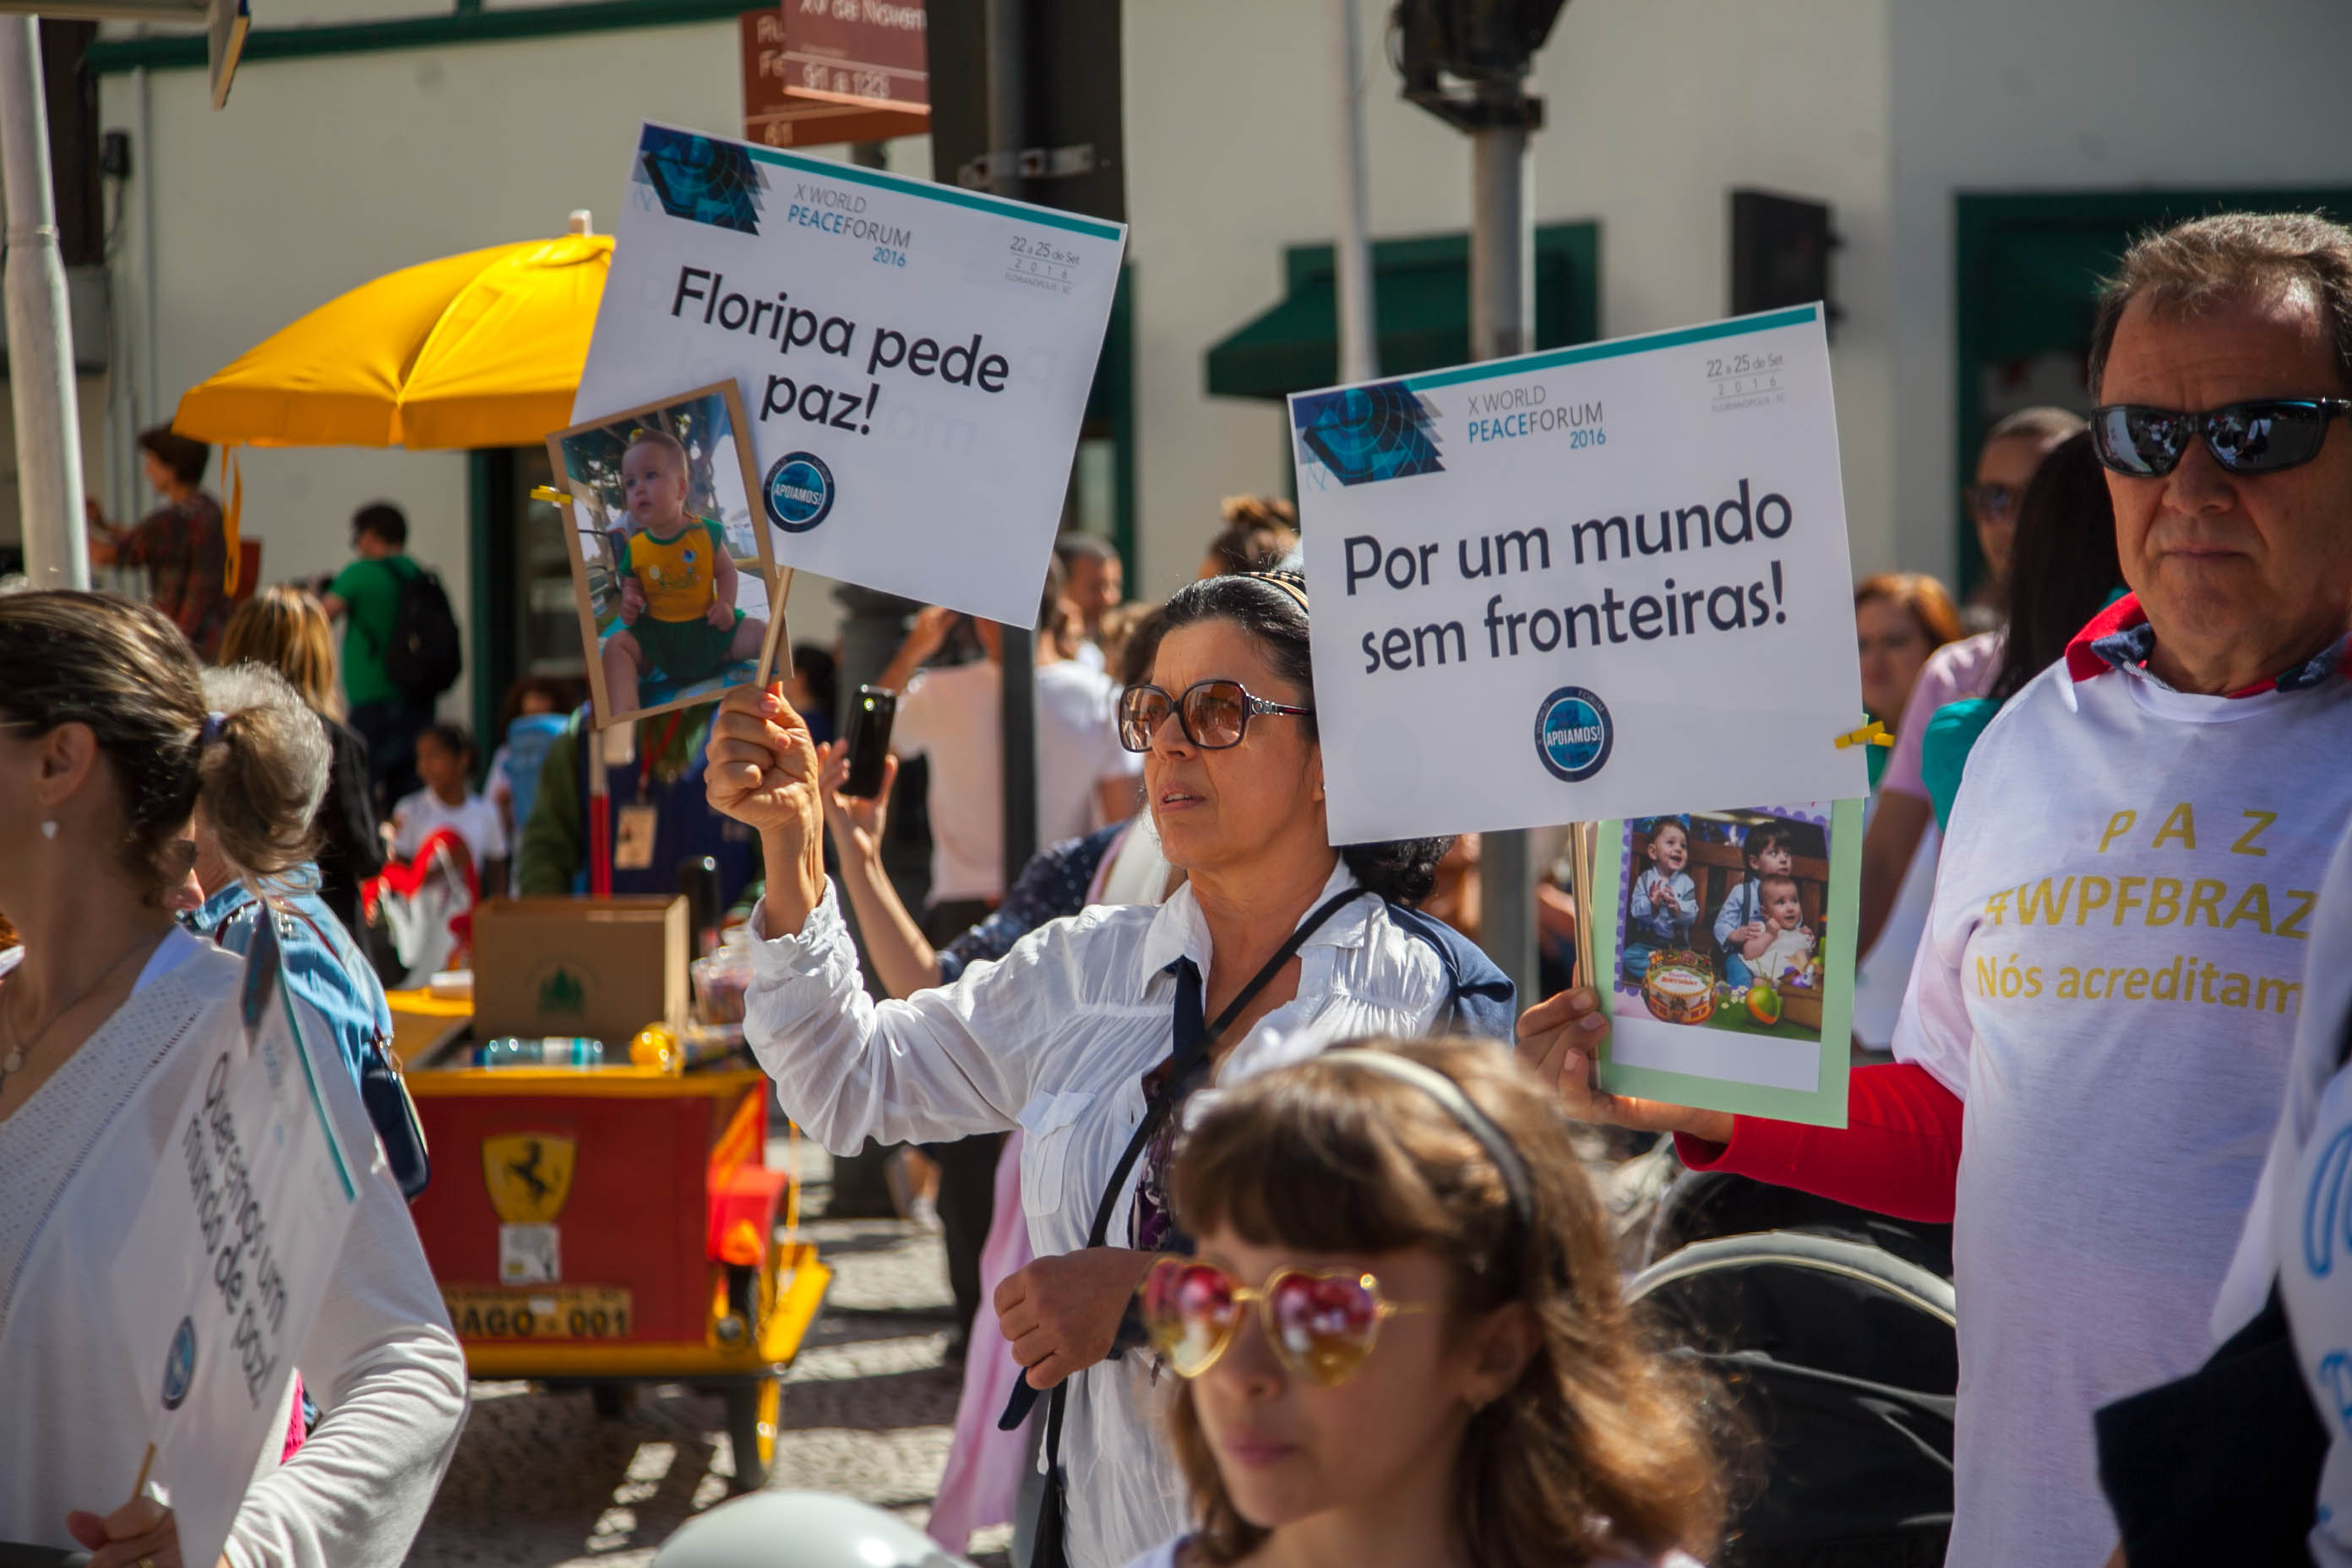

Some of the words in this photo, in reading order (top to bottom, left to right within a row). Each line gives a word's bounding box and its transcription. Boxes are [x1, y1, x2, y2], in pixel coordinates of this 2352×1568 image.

[794, 182, 807, 201] X
[809, 186, 867, 214] WORLD
[787, 204, 911, 248] PEACEFORUM
[872, 246, 906, 268] 2016
[1010, 236, 1026, 253] 22
[1035, 242, 1051, 258] 25
[672, 264, 856, 356] Floripa
[867, 326, 1010, 393] pede
[1706, 358, 1723, 378] 22
[1734, 353, 1750, 373] 25
[760, 373, 881, 435] paz!
[1467, 395, 1479, 416] X
[1483, 384, 1547, 413] WORLD
[1468, 400, 1603, 444] PEACEFORUM
[1570, 427, 1606, 449] 2016
[773, 482, 823, 505] APOIAMOS!
[1343, 535, 1438, 596] Por
[1458, 525, 1550, 579] um
[1571, 478, 1793, 565] mundo
[1362, 619, 1467, 674] sem
[1484, 560, 1786, 658] fronteiras!
[1546, 725, 1602, 748] APOIAMOS!
[1976, 953, 2043, 999] Nós
[2055, 955, 2304, 1017] acreditam
[203, 1051, 265, 1259] Queremos
[258, 1245, 286, 1336] um
[182, 1113, 223, 1255] mundo
[215, 1241, 243, 1315] de
[231, 1300, 280, 1411] paz!
[569, 1309, 627, 1338] 001
